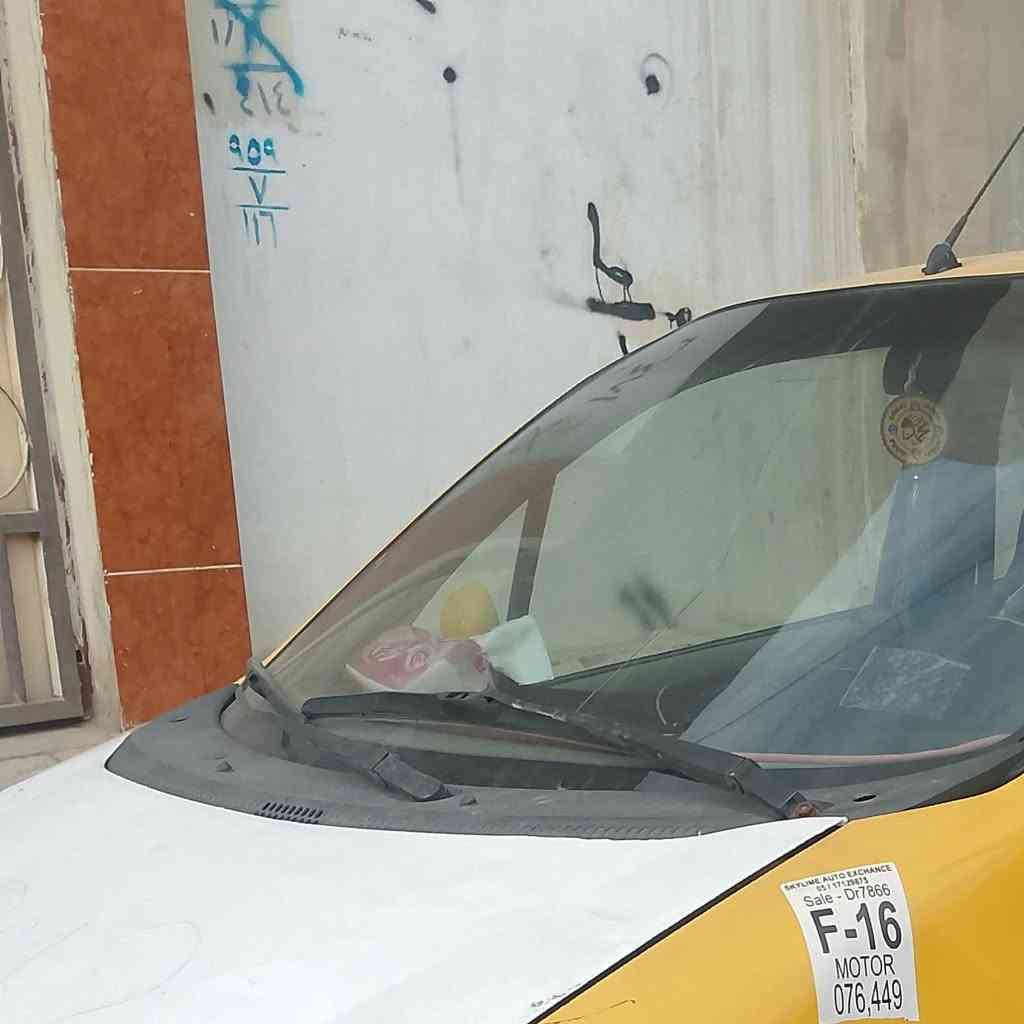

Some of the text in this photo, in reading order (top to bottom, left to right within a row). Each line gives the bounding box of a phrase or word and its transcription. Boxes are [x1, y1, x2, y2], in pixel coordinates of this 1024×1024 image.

[803, 893, 834, 908] Sale
[844, 883, 891, 901] Dr7866
[809, 900, 902, 954] F-16
[834, 954, 896, 979] MOTOR
[833, 979, 903, 1017] 076,449
